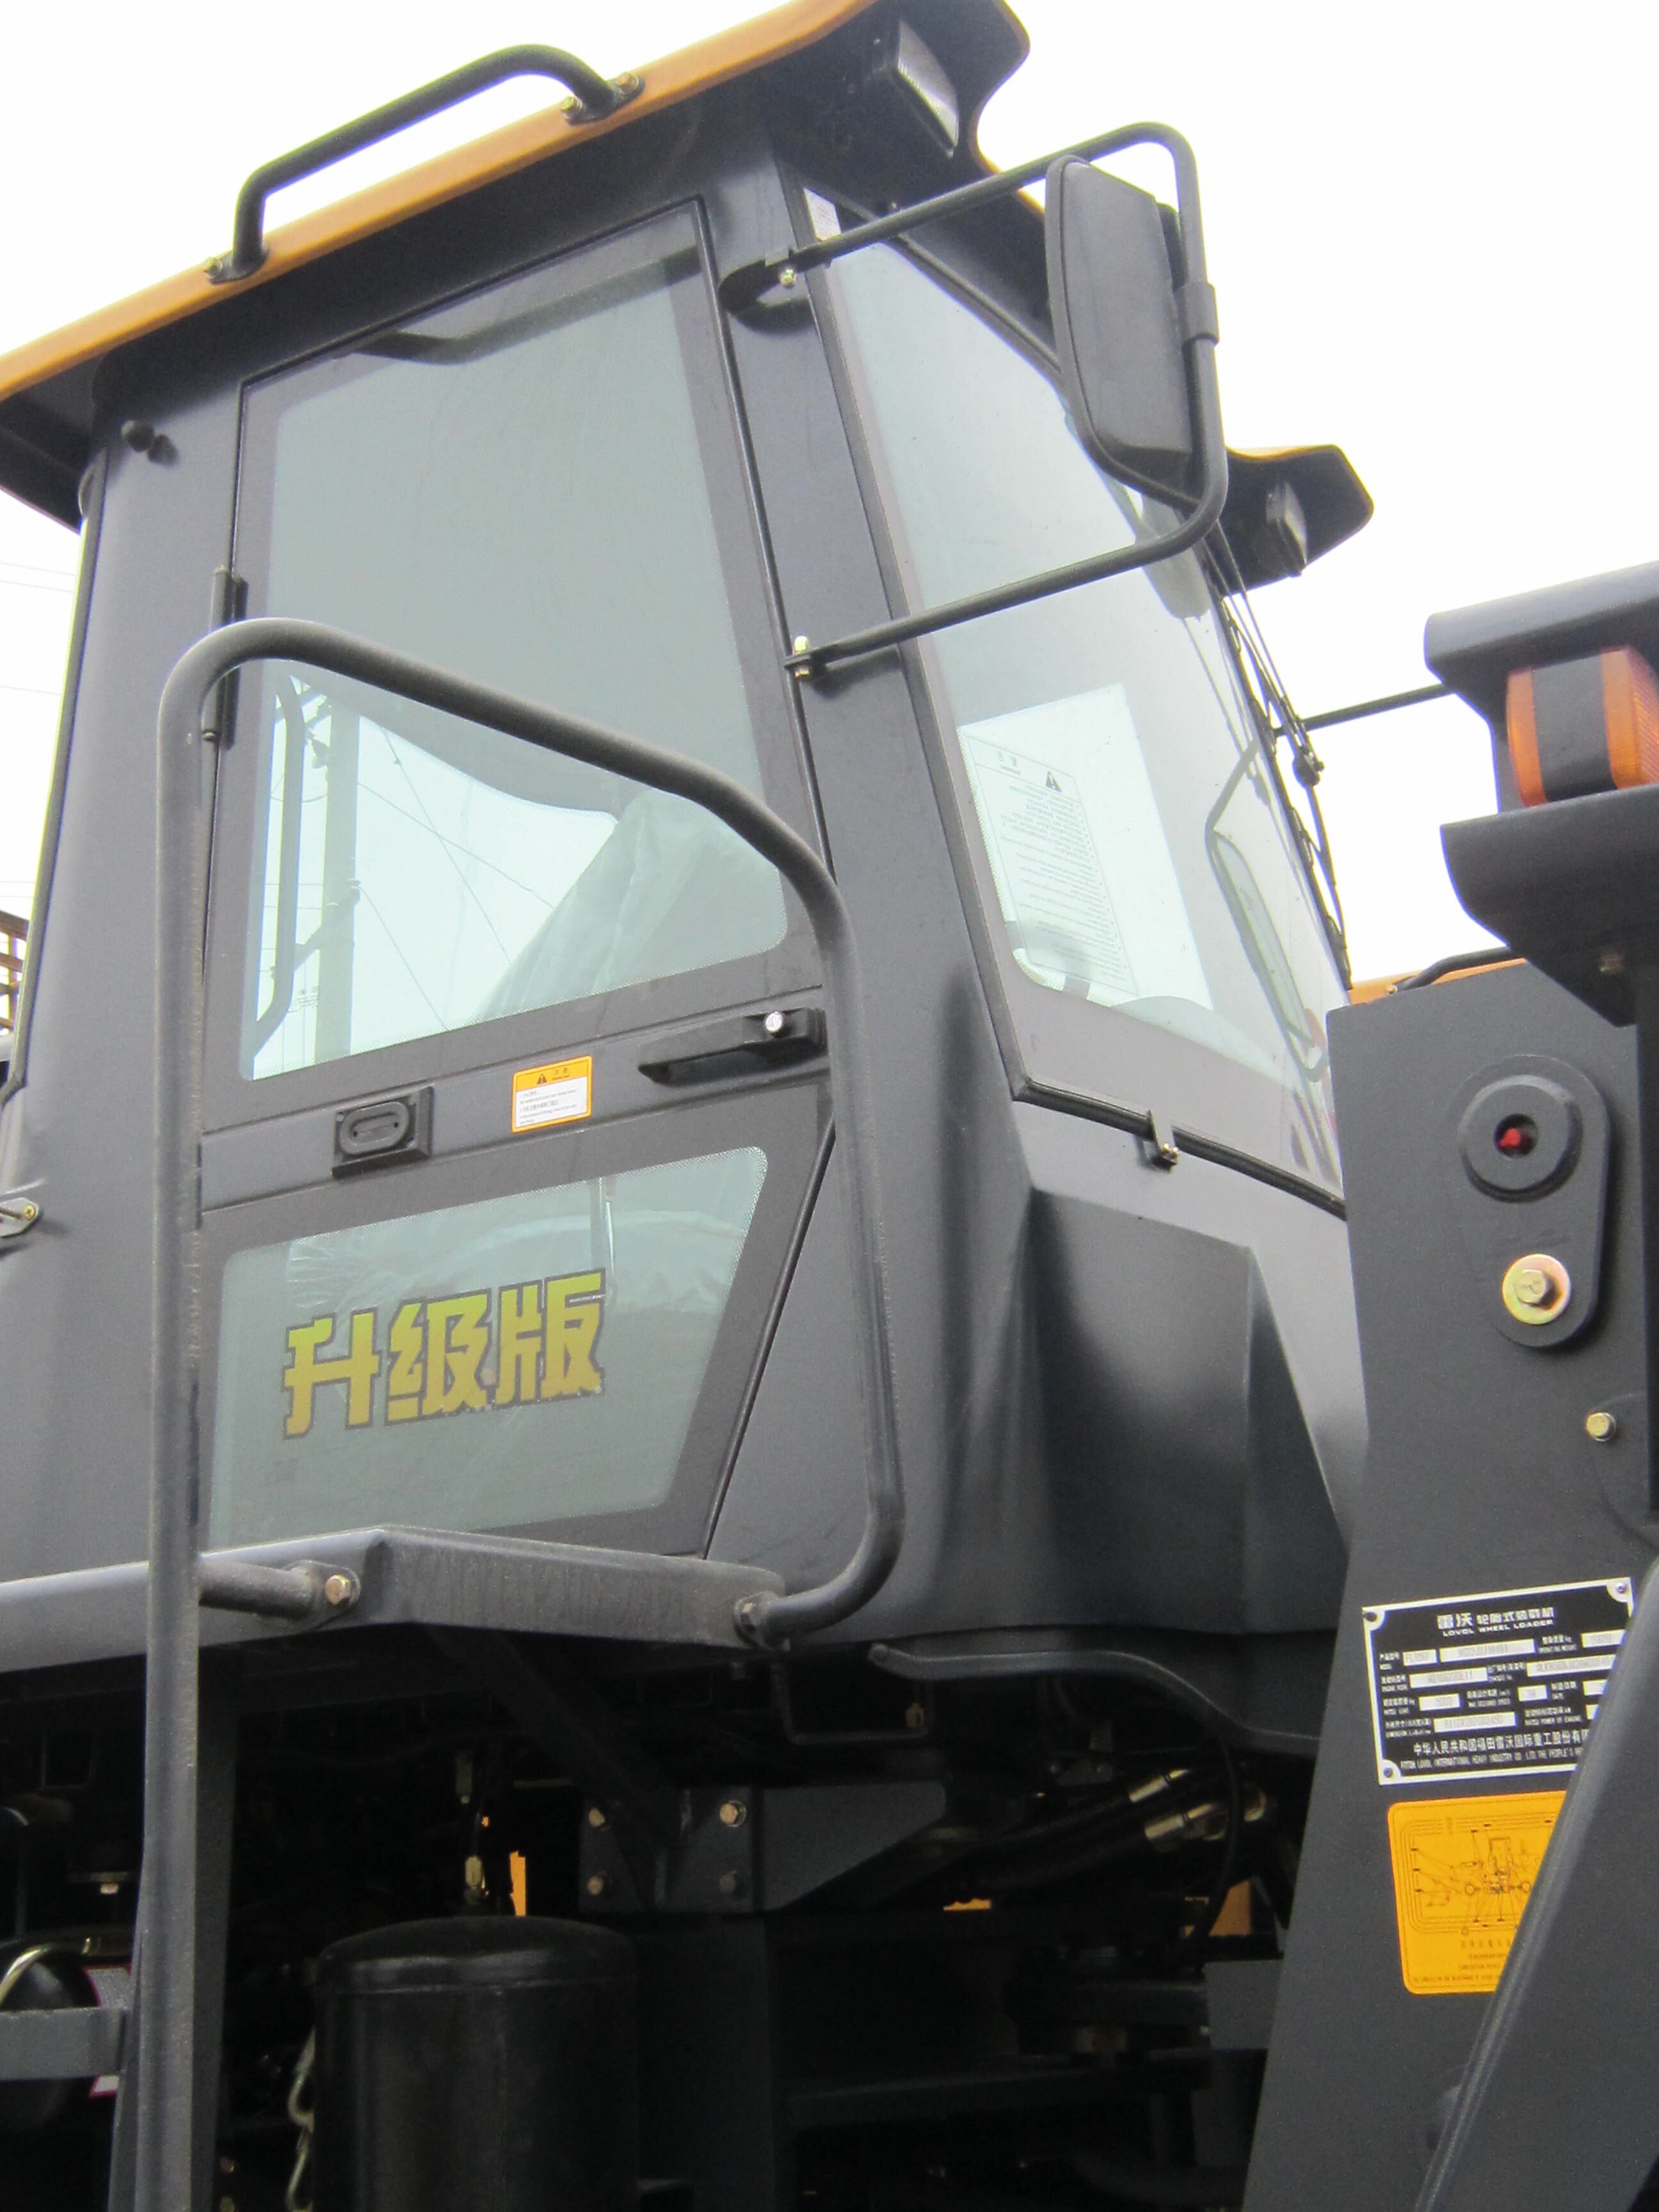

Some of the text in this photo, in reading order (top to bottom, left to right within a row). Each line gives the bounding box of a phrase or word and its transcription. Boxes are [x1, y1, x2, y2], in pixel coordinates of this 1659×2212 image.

[282, 1269, 606, 1439] 升级版
[1437, 1612, 1473, 1630] 雷沃
[1442, 1619, 1553, 1637] LOVOL WHEEL LOADER
